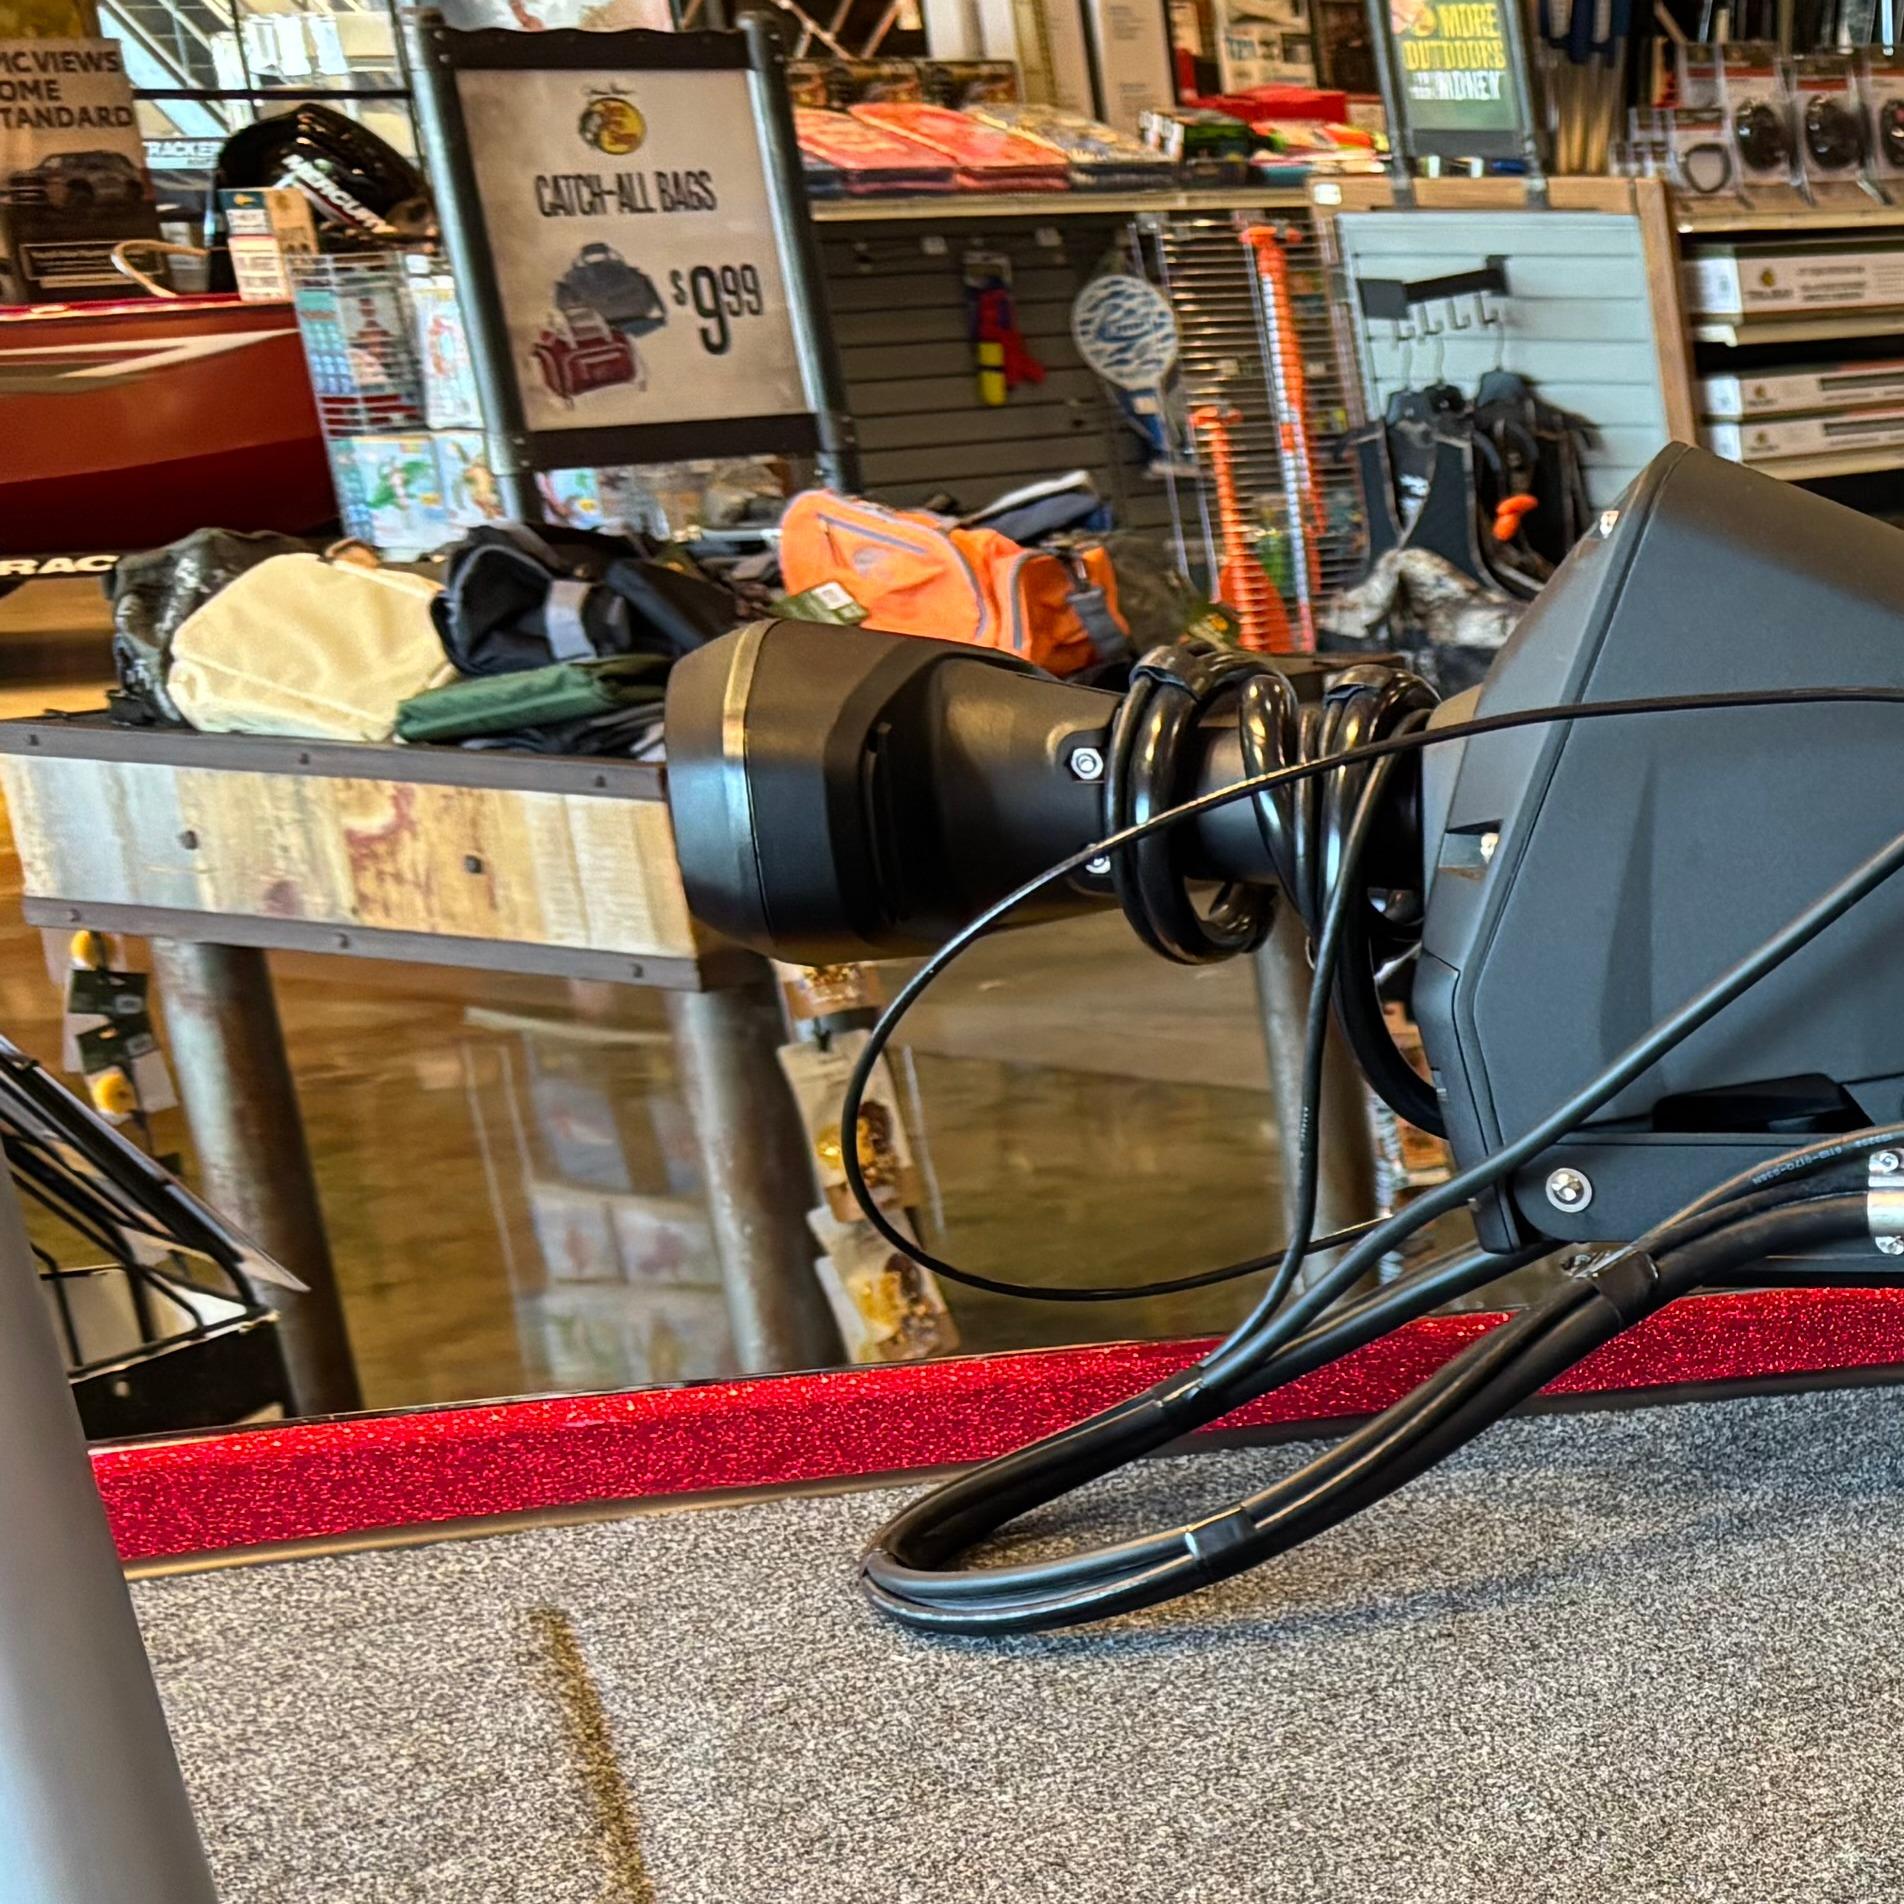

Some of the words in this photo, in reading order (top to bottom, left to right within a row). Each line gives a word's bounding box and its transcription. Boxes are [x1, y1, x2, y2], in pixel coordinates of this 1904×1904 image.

[1436, 2, 1499, 38] MORE
[31, 50, 119, 73] VIEWS
[1402, 40, 1507, 70] OUTDOORS
[534, 172, 656, 217] CATCH-ALL
[655, 170, 718, 213] BAGS
